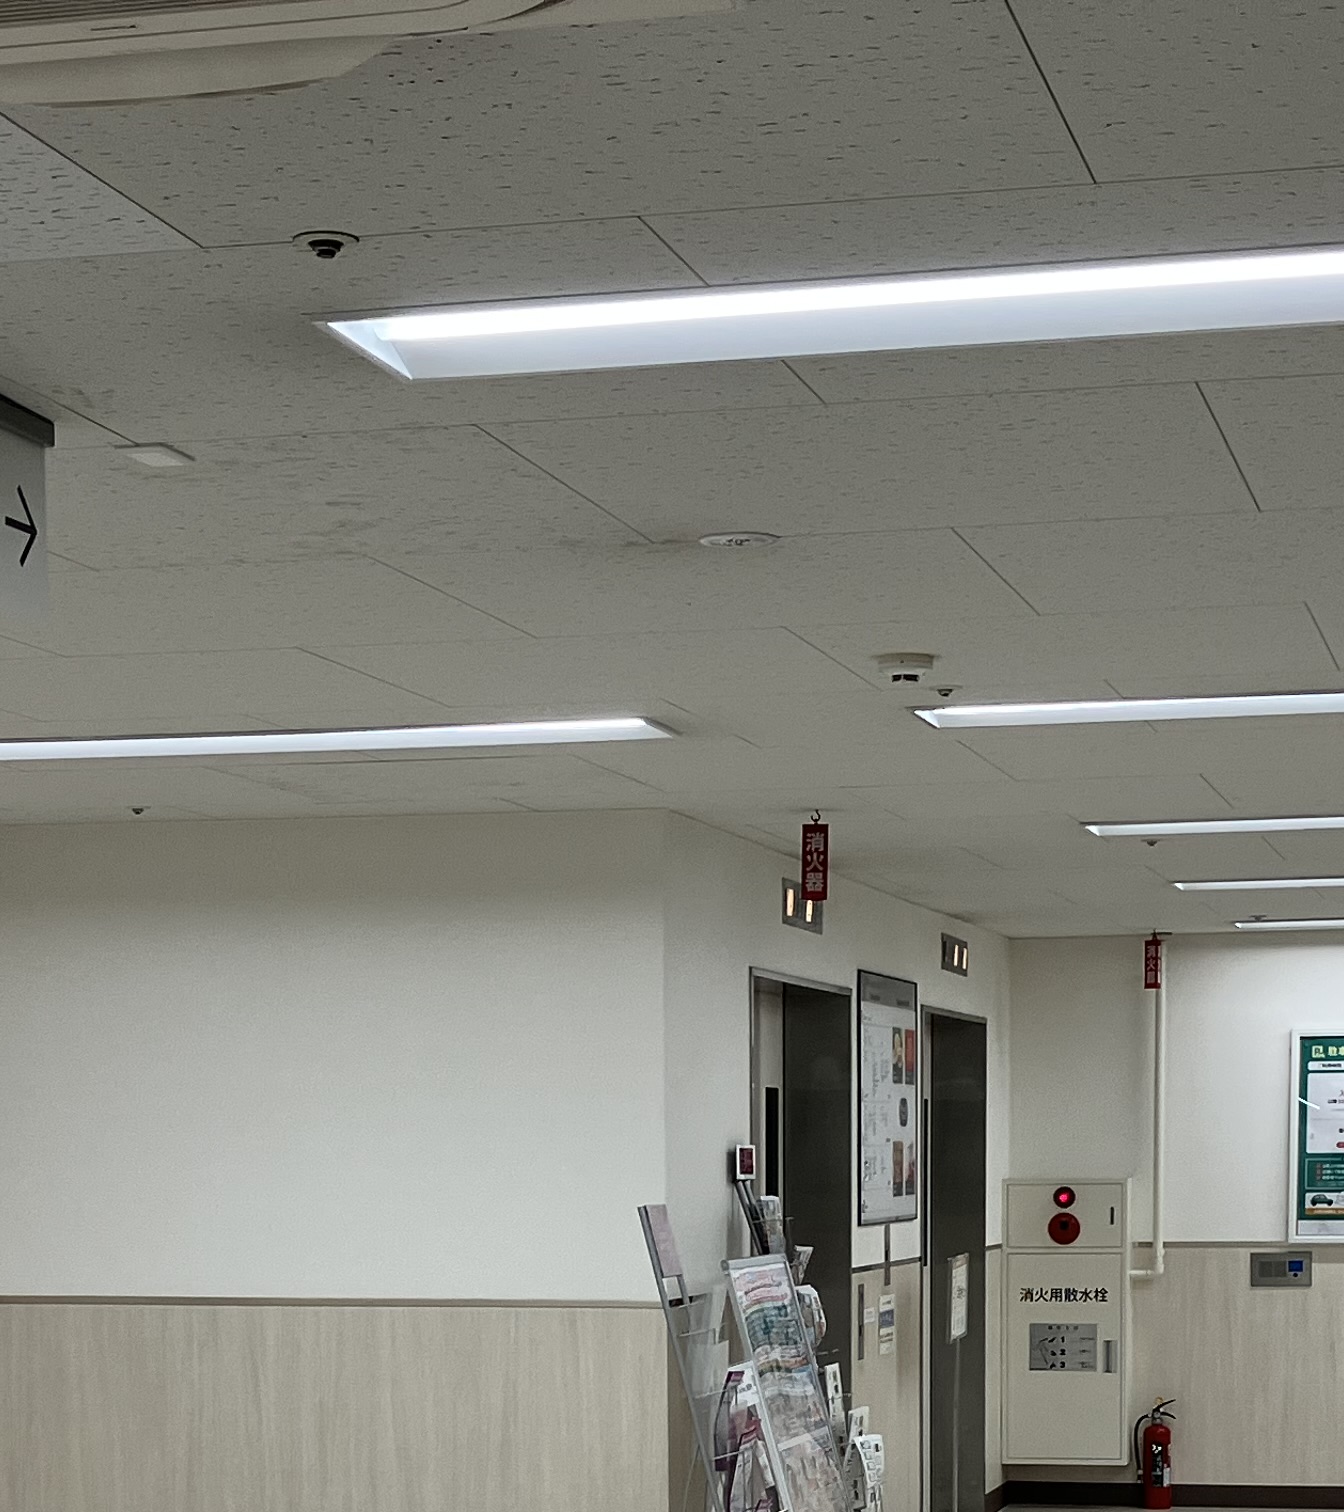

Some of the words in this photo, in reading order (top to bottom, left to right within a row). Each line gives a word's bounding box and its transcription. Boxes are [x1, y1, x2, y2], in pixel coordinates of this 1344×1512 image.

[805, 832, 825, 892] 消火器
[1019, 1287, 1109, 1303] 消火用散水栓
